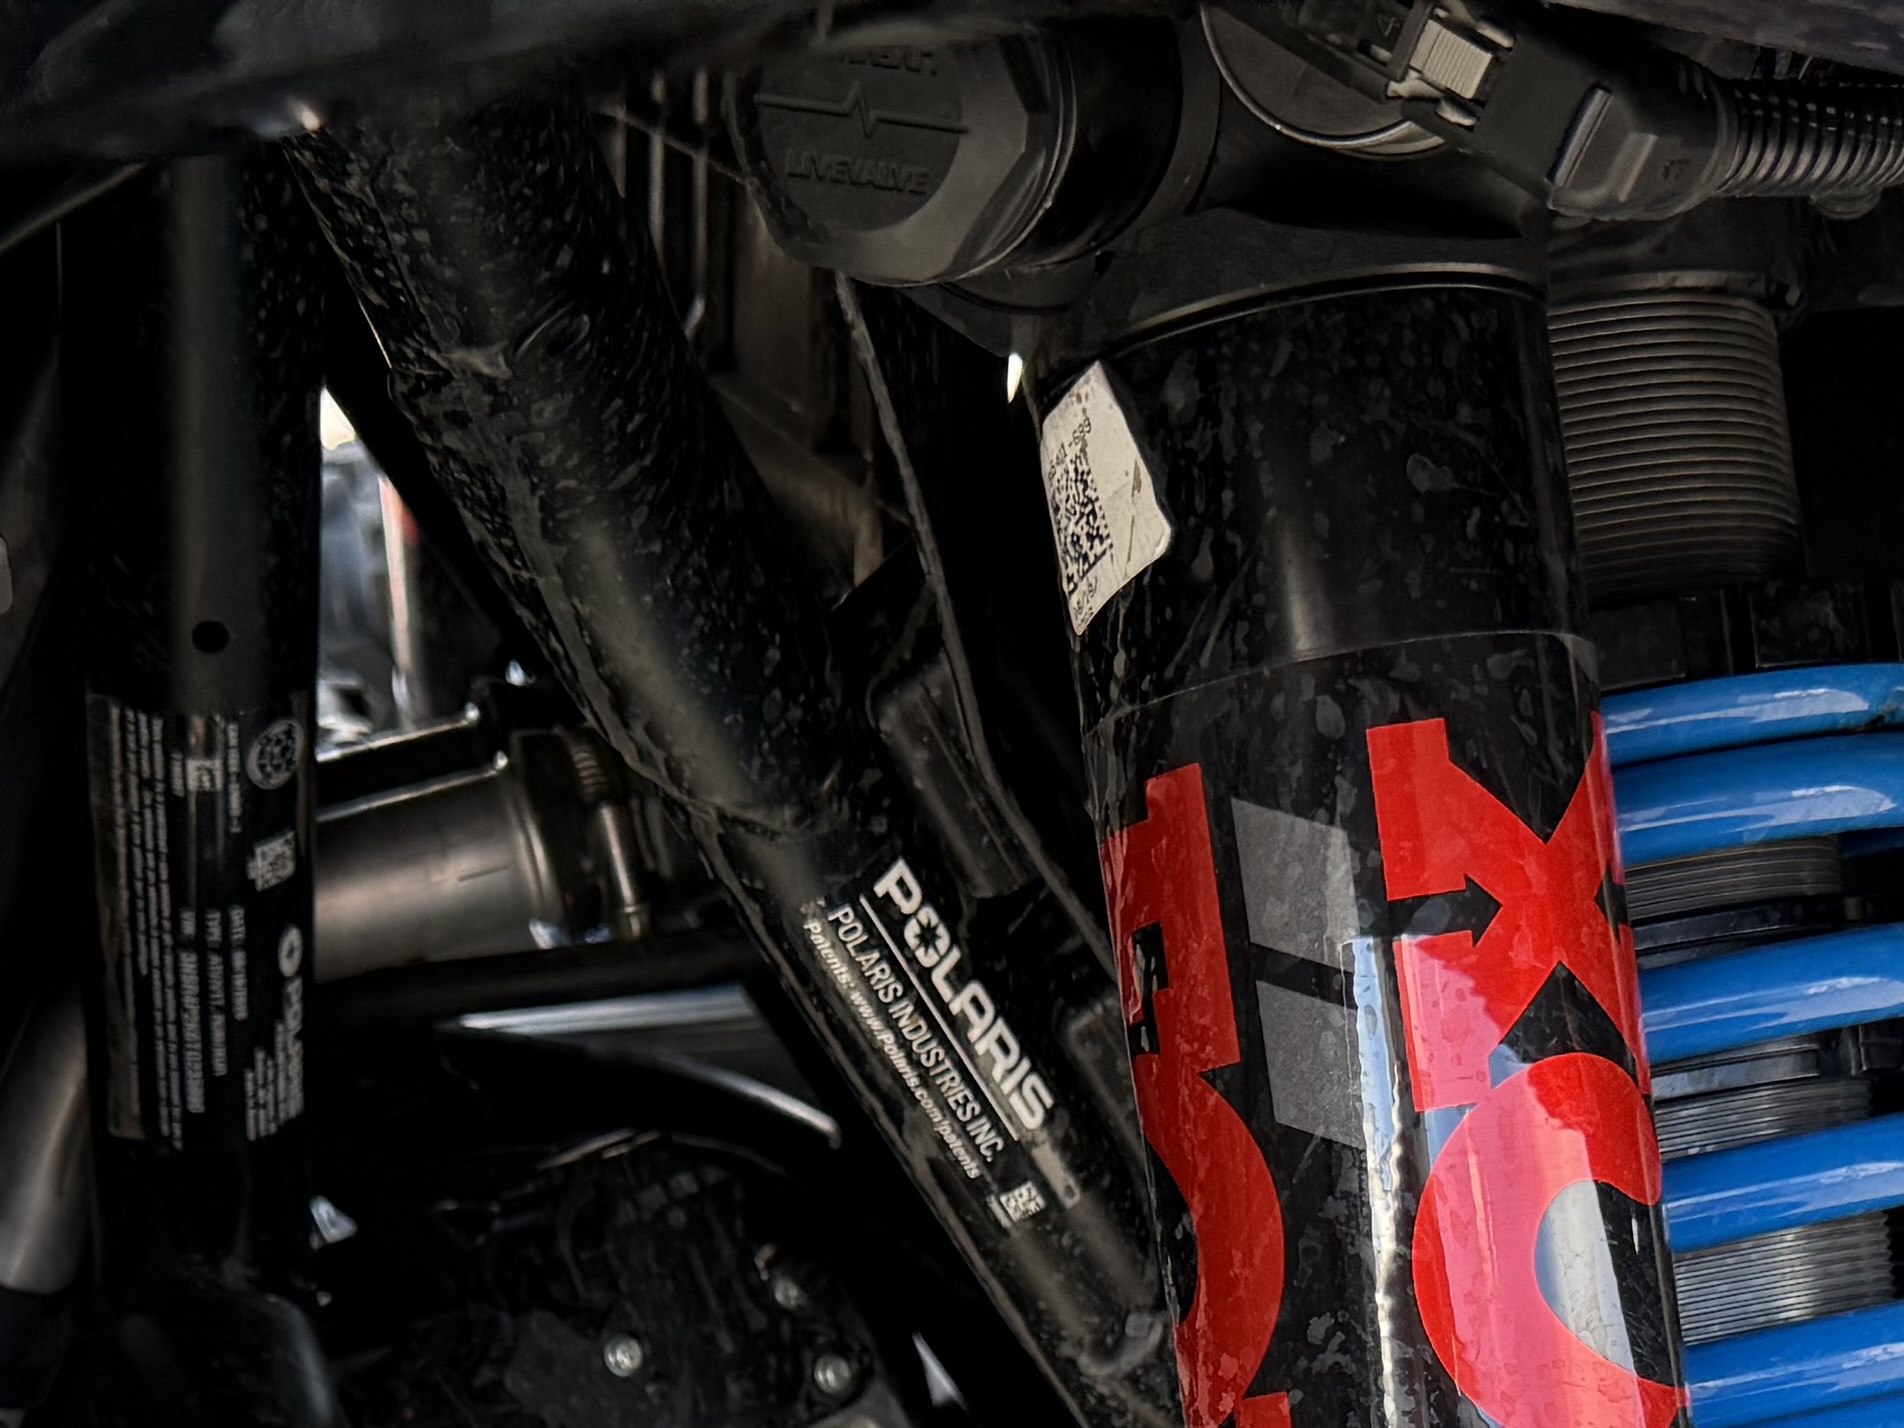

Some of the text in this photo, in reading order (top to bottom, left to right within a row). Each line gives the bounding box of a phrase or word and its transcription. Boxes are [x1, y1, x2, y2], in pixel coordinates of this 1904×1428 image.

[803, 920, 856, 991] Patents:
[828, 903, 1005, 1162] POLARIS INDUSTRIES INC.
[873, 856, 1054, 1131] POLARIS
